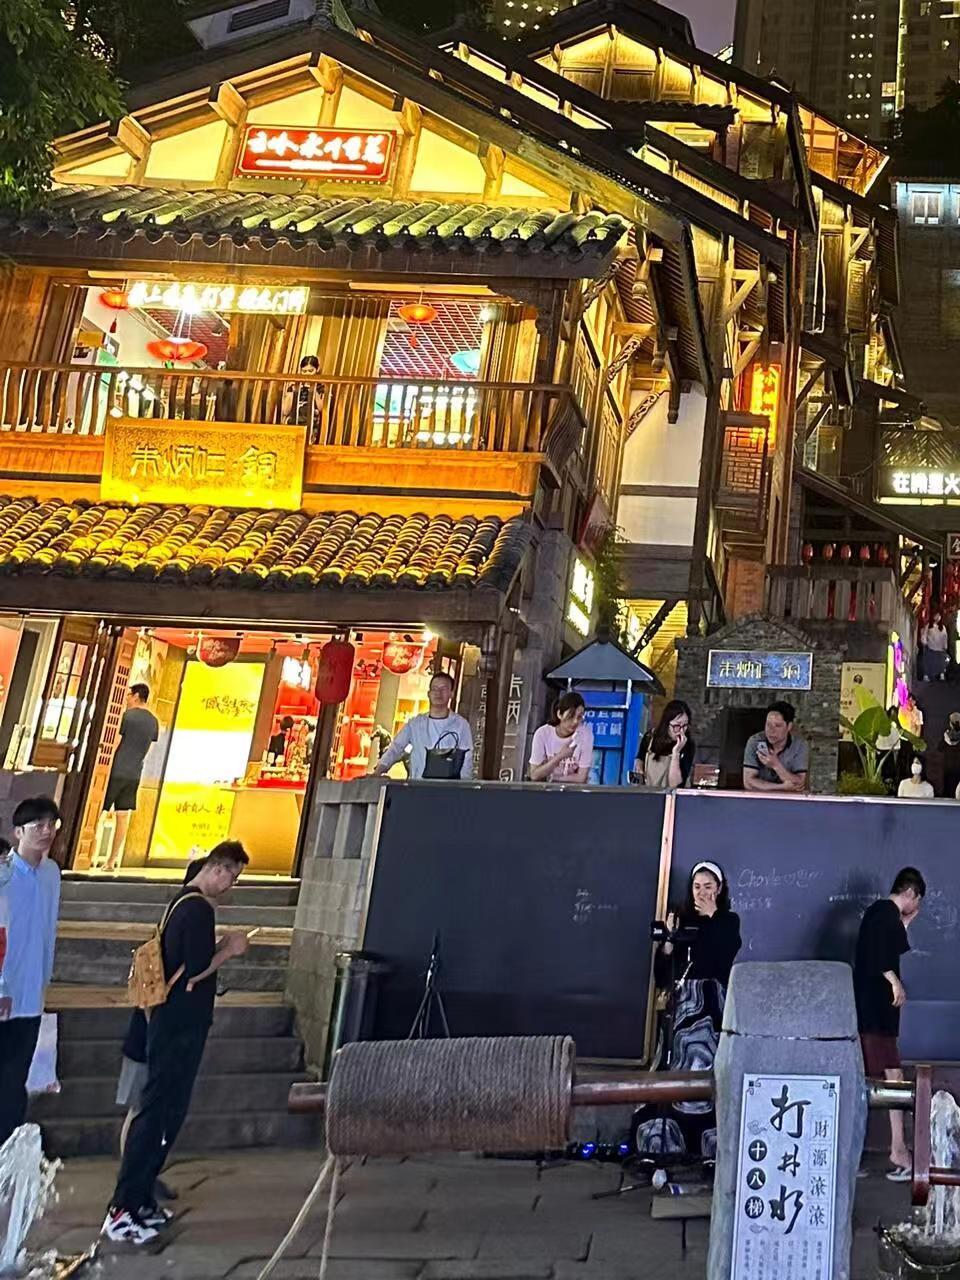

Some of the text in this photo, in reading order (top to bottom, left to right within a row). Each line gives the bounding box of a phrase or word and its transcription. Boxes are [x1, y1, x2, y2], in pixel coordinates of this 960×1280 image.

[747, 1141, 767, 1217] 十八梯
[768, 1084, 811, 1235] 打井水
